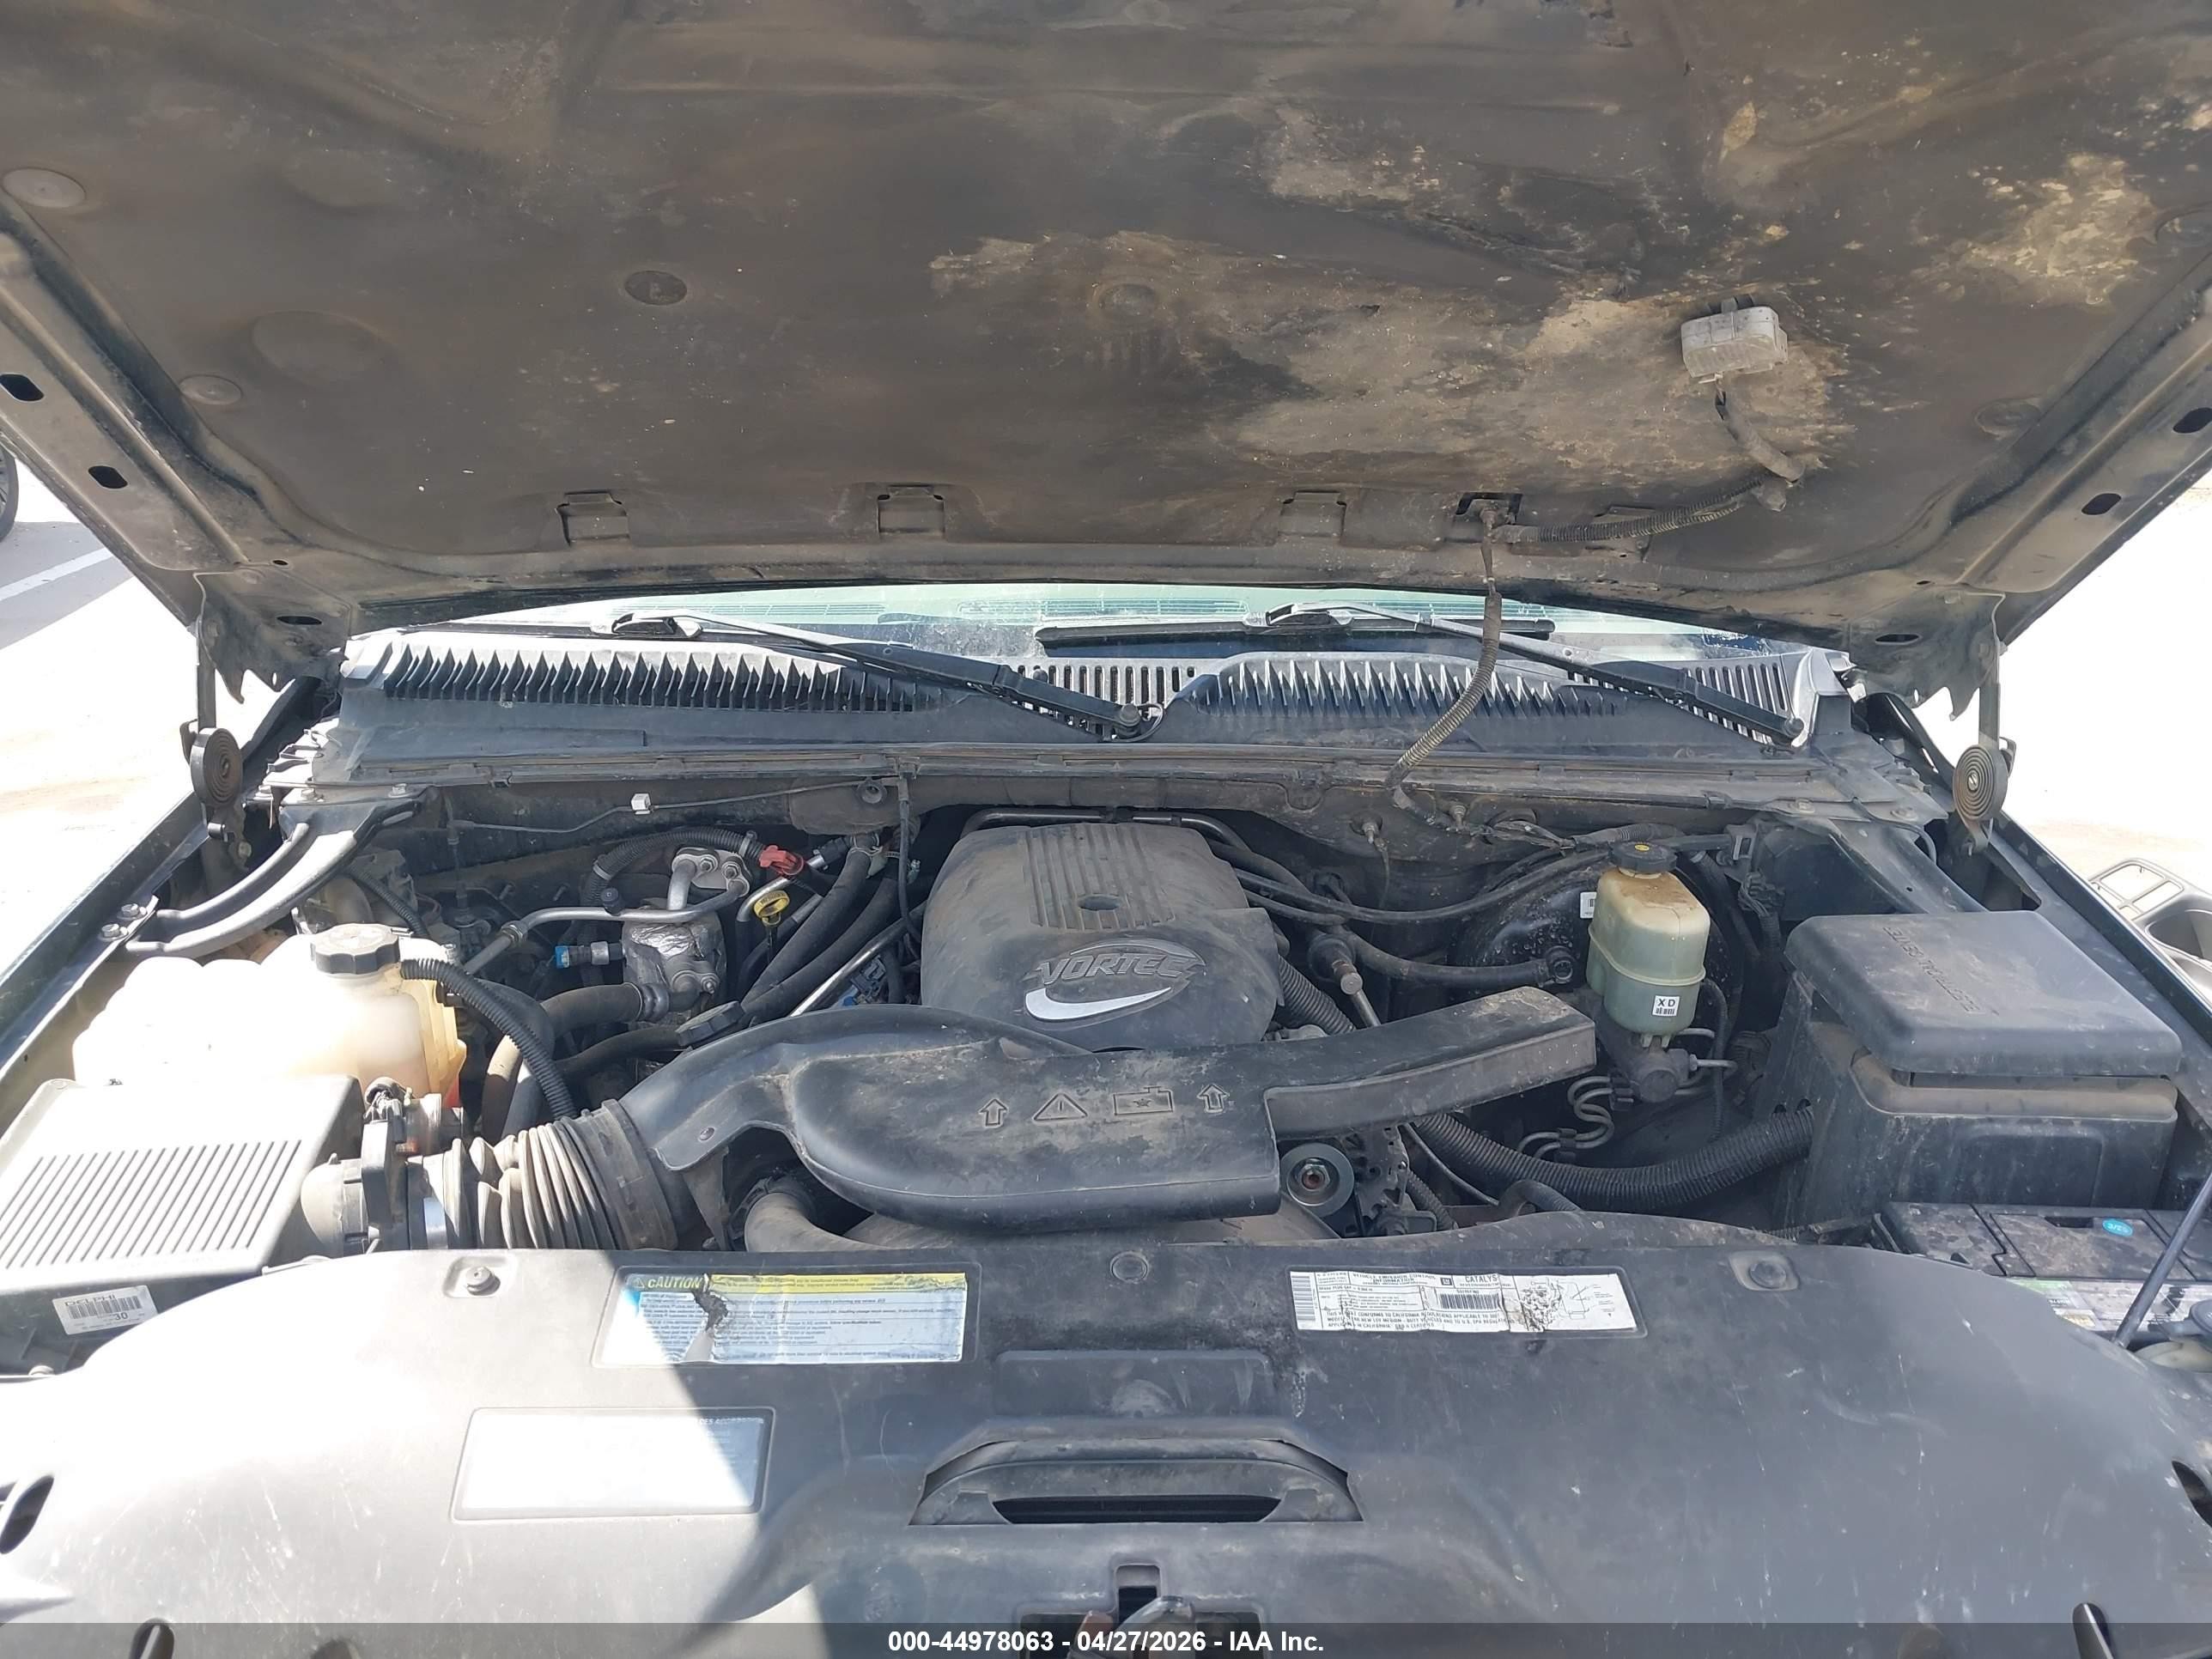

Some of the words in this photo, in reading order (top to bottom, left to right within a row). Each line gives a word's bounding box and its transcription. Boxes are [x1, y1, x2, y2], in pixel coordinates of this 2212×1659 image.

[1035, 952, 1195, 985] VORTEC
[64, 1294, 116, 1306] DELPHI
[112, 1311, 129, 1321] 30
